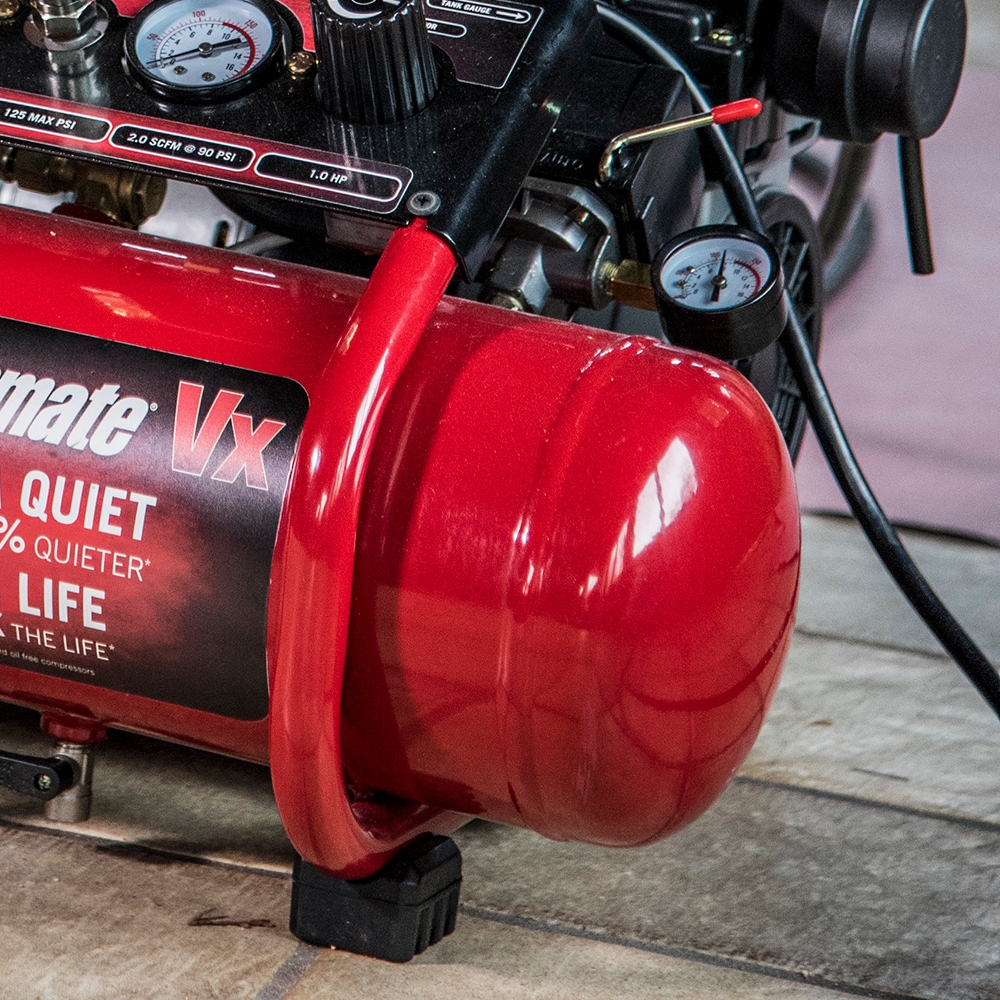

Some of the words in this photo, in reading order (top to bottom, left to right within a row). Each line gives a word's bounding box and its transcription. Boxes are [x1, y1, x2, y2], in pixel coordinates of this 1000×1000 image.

[192, 10, 206, 18] 100
[440, 0, 463, 10] TANK
[463, 3, 492, 15] GAUGE
[225, 63, 235, 71] 16
[233, 52, 242, 60] 14
[4, 107, 27, 119] 125
[27, 112, 56, 126] MAX
[56, 117, 77, 130] PSI
[126, 132, 148, 144] 2.0
[149, 137, 183, 151] SCFM
[184, 143, 196, 154] @
[197, 147, 214, 158] 90
[216, 150, 237, 162] PSI
[308, 168, 328, 181] 1.0
[329, 172, 348, 185] HP
[20, 470, 158, 541] QUIET
[18, 572, 107, 632] LIFE
[10, 622, 57, 649] THE
[10, 651, 21, 659] oil
[22, 653, 39, 663] free
[41, 657, 96, 676] compressors
